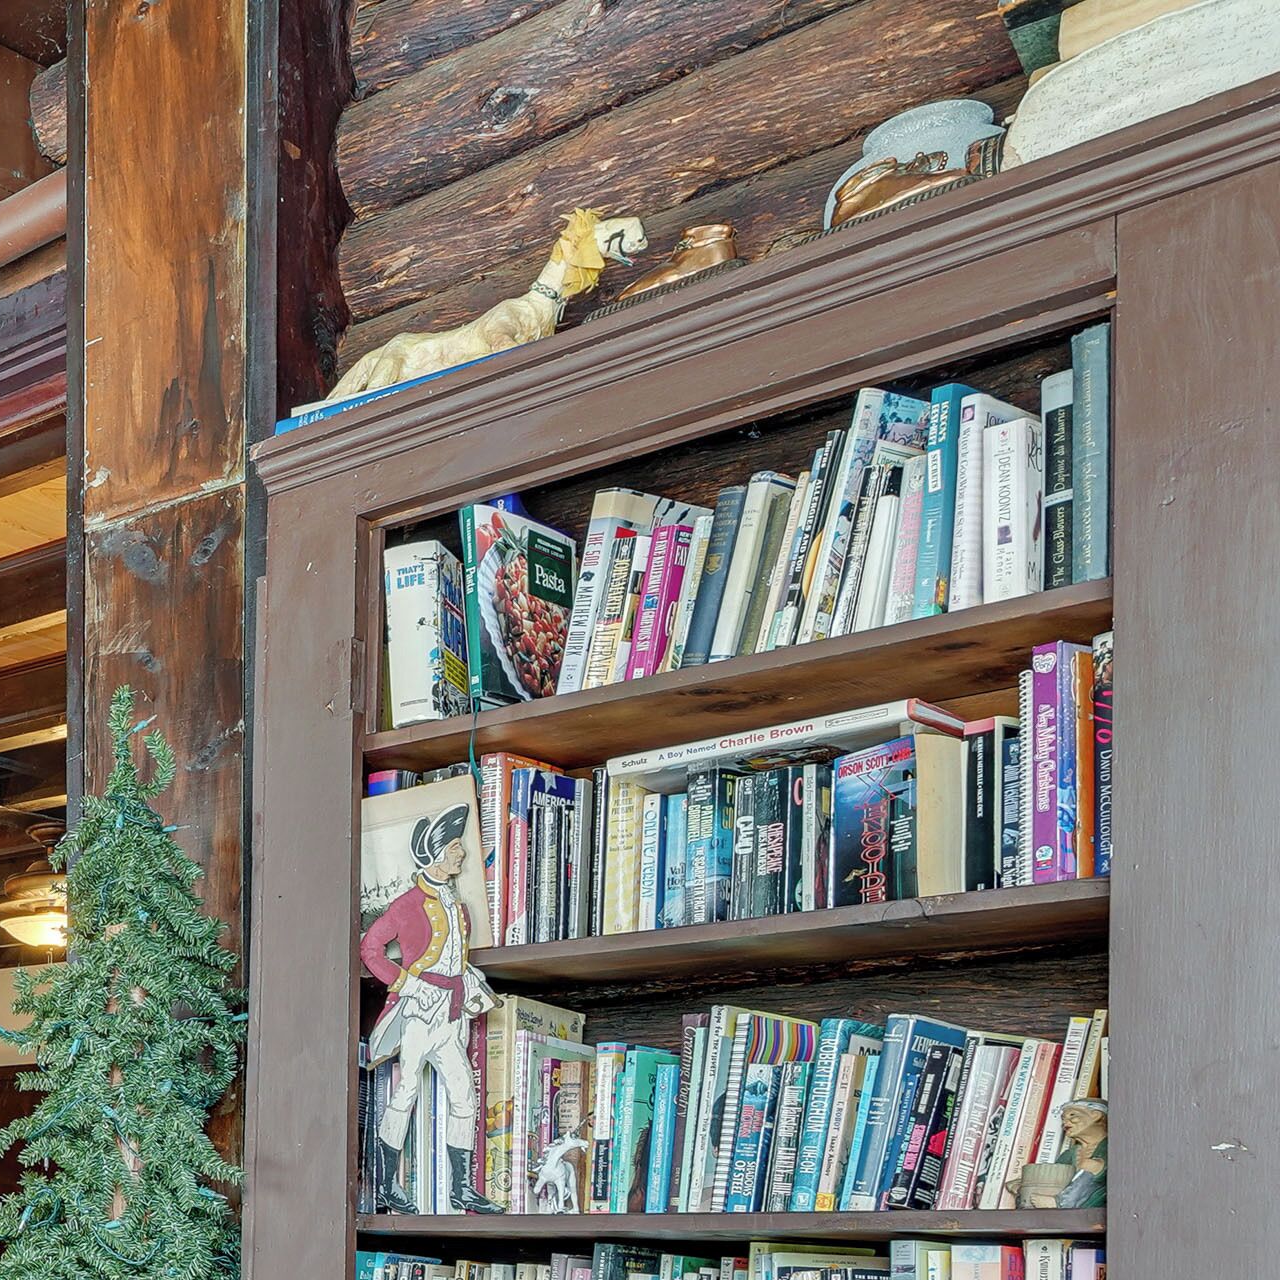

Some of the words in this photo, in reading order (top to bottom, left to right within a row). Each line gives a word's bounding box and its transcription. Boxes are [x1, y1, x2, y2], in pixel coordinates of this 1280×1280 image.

[1055, 408, 1066, 446] Maurier
[930, 453, 939, 490] SECRETS
[997, 457, 1011, 484] DEAN
[1053, 456, 1066, 492] Daphne
[804, 479, 823, 531] ALLERGIES
[998, 486, 1011, 523] KOONTZ
[587, 532, 604, 546] THE
[796, 534, 810, 553] AND
[1053, 506, 1066, 563] Glass-Blowers
[397, 562, 424, 576] THAT'S
[794, 555, 806, 573] YOU
[1004, 551, 1014, 576] False
[1053, 565, 1066, 587] The
[397, 572, 425, 590] LIFE
[465, 566, 474, 596] Pasta
[535, 563, 566, 594] Pasta
[573, 586, 594, 627] MATTHEW
[566, 631, 586, 657] QUIRK
[658, 754, 666, 762] A
[667, 751, 684, 760] Boy
[686, 743, 717, 756] Named
[719, 733, 766, 750] Charlie
[769, 722, 814, 740] Brown
[1034, 726, 1056, 760] Minty
[621, 756, 648, 768] Schulz
[838, 761, 864, 779] ORSON
[865, 754, 890, 772] SCOTT
[1004, 765, 1017, 782] John
[1099, 750, 1112, 782] DAVID
[1035, 761, 1056, 812] Christmas
[688, 804, 700, 844] CORNWELL
[700, 805, 713, 839] PATRICIA
[766, 822, 784, 874] CHESAPEAKE
[693, 856, 706, 896] SCARPETTA
[693, 896, 705, 923] FACTOR
[1067, 1038, 1081, 1051] SUN
[1070, 1026, 1083, 1038] THE
[681, 1026, 697, 1078] Creating
[815, 1038, 837, 1079] ROBERT
[1021, 1055, 1032, 1071] THE
[1064, 1051, 1077, 1066] ALSO
[1015, 1071, 1028, 1094] WEST
[1060, 1064, 1074, 1084] RISES
[678, 1080, 693, 1118] Poetry
[784, 1086, 805, 1105] Linda
[806, 1081, 831, 1133] FULGHUM
[1010, 1092, 1021, 1109] END
[779, 1106, 801, 1138] Fairstein
[833, 1108, 841, 1132] ROBOT
[1003, 1108, 1017, 1137] HORROR
[830, 1134, 839, 1152] Isaac
[1044, 1130, 1056, 1151] ERNEST
[734, 1160, 745, 1172] OF
[775, 1147, 796, 1173] LIKELY
[800, 1145, 818, 1174] UH-OH
[824, 1154, 834, 1177] Asimov
[731, 1173, 743, 1195] STEEL
[743, 1161, 757, 1196] SHADOWS
[772, 1182, 792, 1196] DIE
[951, 1157, 975, 1201] Hunter
